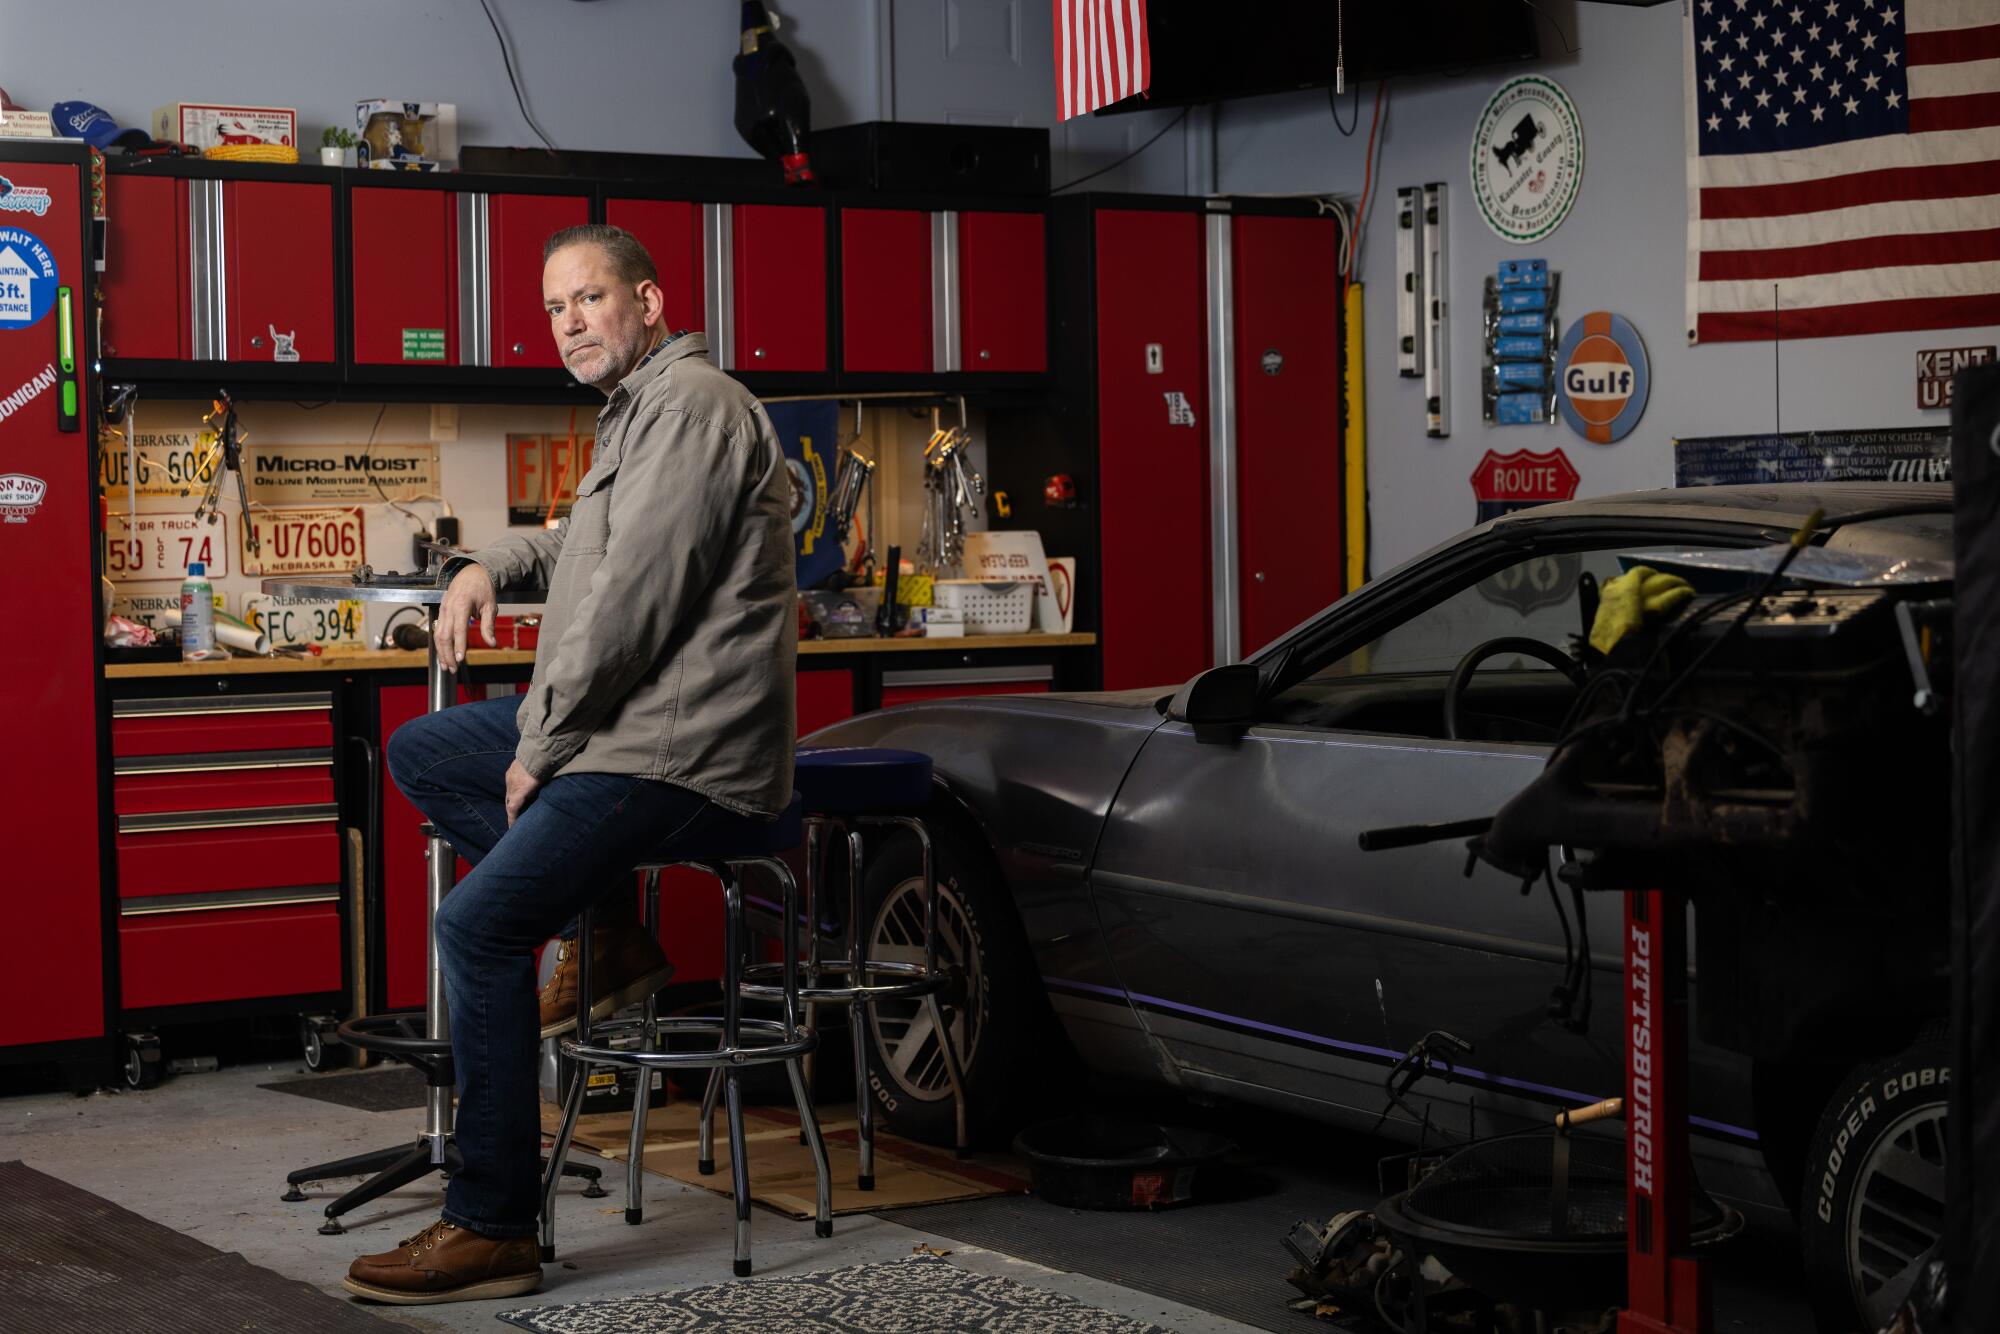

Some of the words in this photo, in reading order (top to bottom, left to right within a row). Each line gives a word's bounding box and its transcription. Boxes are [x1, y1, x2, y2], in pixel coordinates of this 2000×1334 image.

[0, 231, 33, 247] WAIT
[31, 243, 54, 278] HERE
[1917, 348, 1989, 379] KENT
[1567, 368, 1631, 394] Gulf
[167, 450, 212, 485] 608
[255, 455, 421, 473] MICRO-MOIST
[17, 480, 41, 494] JON
[253, 476, 304, 487] ON-LINE
[305, 475, 366, 486] MOISTURE
[367, 475, 428, 487] ANALYZER
[1493, 467, 1558, 493] ROUTE
[16, 493, 34, 501] SHOP
[123, 521, 155, 531] NBR
[161, 520, 199, 530] TRUCK
[178, 536, 213, 570] 74
[271, 561, 336, 572] NEBRASKA
[253, 610, 296, 644] SFC
[313, 608, 356, 642] 394
[1631, 925, 1654, 1197] PITTSBURGH
[1817, 1094, 1878, 1225] COOPER
